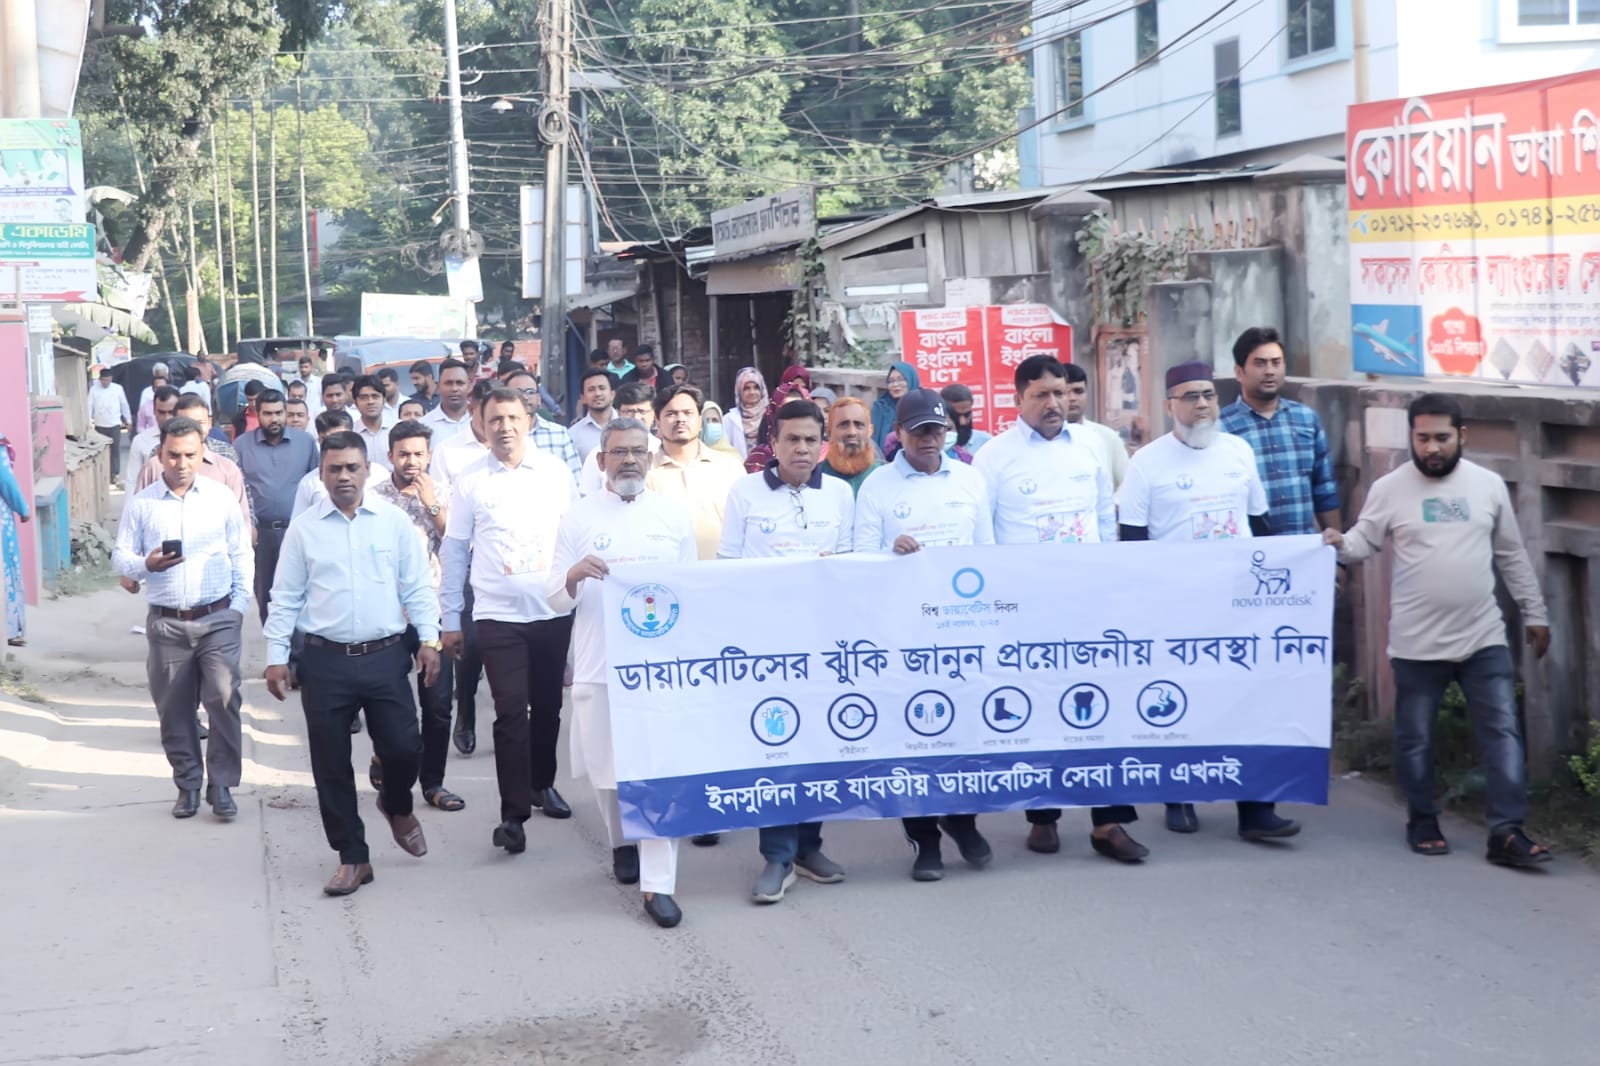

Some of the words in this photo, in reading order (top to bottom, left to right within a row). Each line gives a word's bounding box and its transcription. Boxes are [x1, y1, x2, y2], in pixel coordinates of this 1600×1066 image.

[1351, 97, 1506, 198] কোরিয়ান
[1507, 124, 1565, 178] ভাষা
[918, 330, 967, 347] বাংলা
[1004, 327, 1053, 344] বাংলা
[915, 347, 973, 369] ইংলিশ
[930, 368, 961, 382] ICT
[994, 599, 1018, 614] দিবস
[1232, 597, 1262, 607] novo
[1265, 594, 1312, 606] nordisk
[615, 645, 811, 692] ডায়াবেটিসের
[822, 640, 888, 686] ঝুঁকি
[899, 644, 984, 681] জানুন
[997, 629, 1155, 671] প্রয়োজনীয়
[1164, 632, 1260, 670] ব্যবস্থা
[1271, 625, 1329, 664] নিন
[705, 777, 797, 814] ইনসুলিন
[803, 779, 841, 804] সহ
[846, 767, 930, 800] যাবতীয়
[938, 762, 1053, 797] ডায়াবেটিস
[1061, 763, 1113, 789] সেবা
[1119, 757, 1162, 787] নিন
[1170, 755, 1243, 786] এখনই
